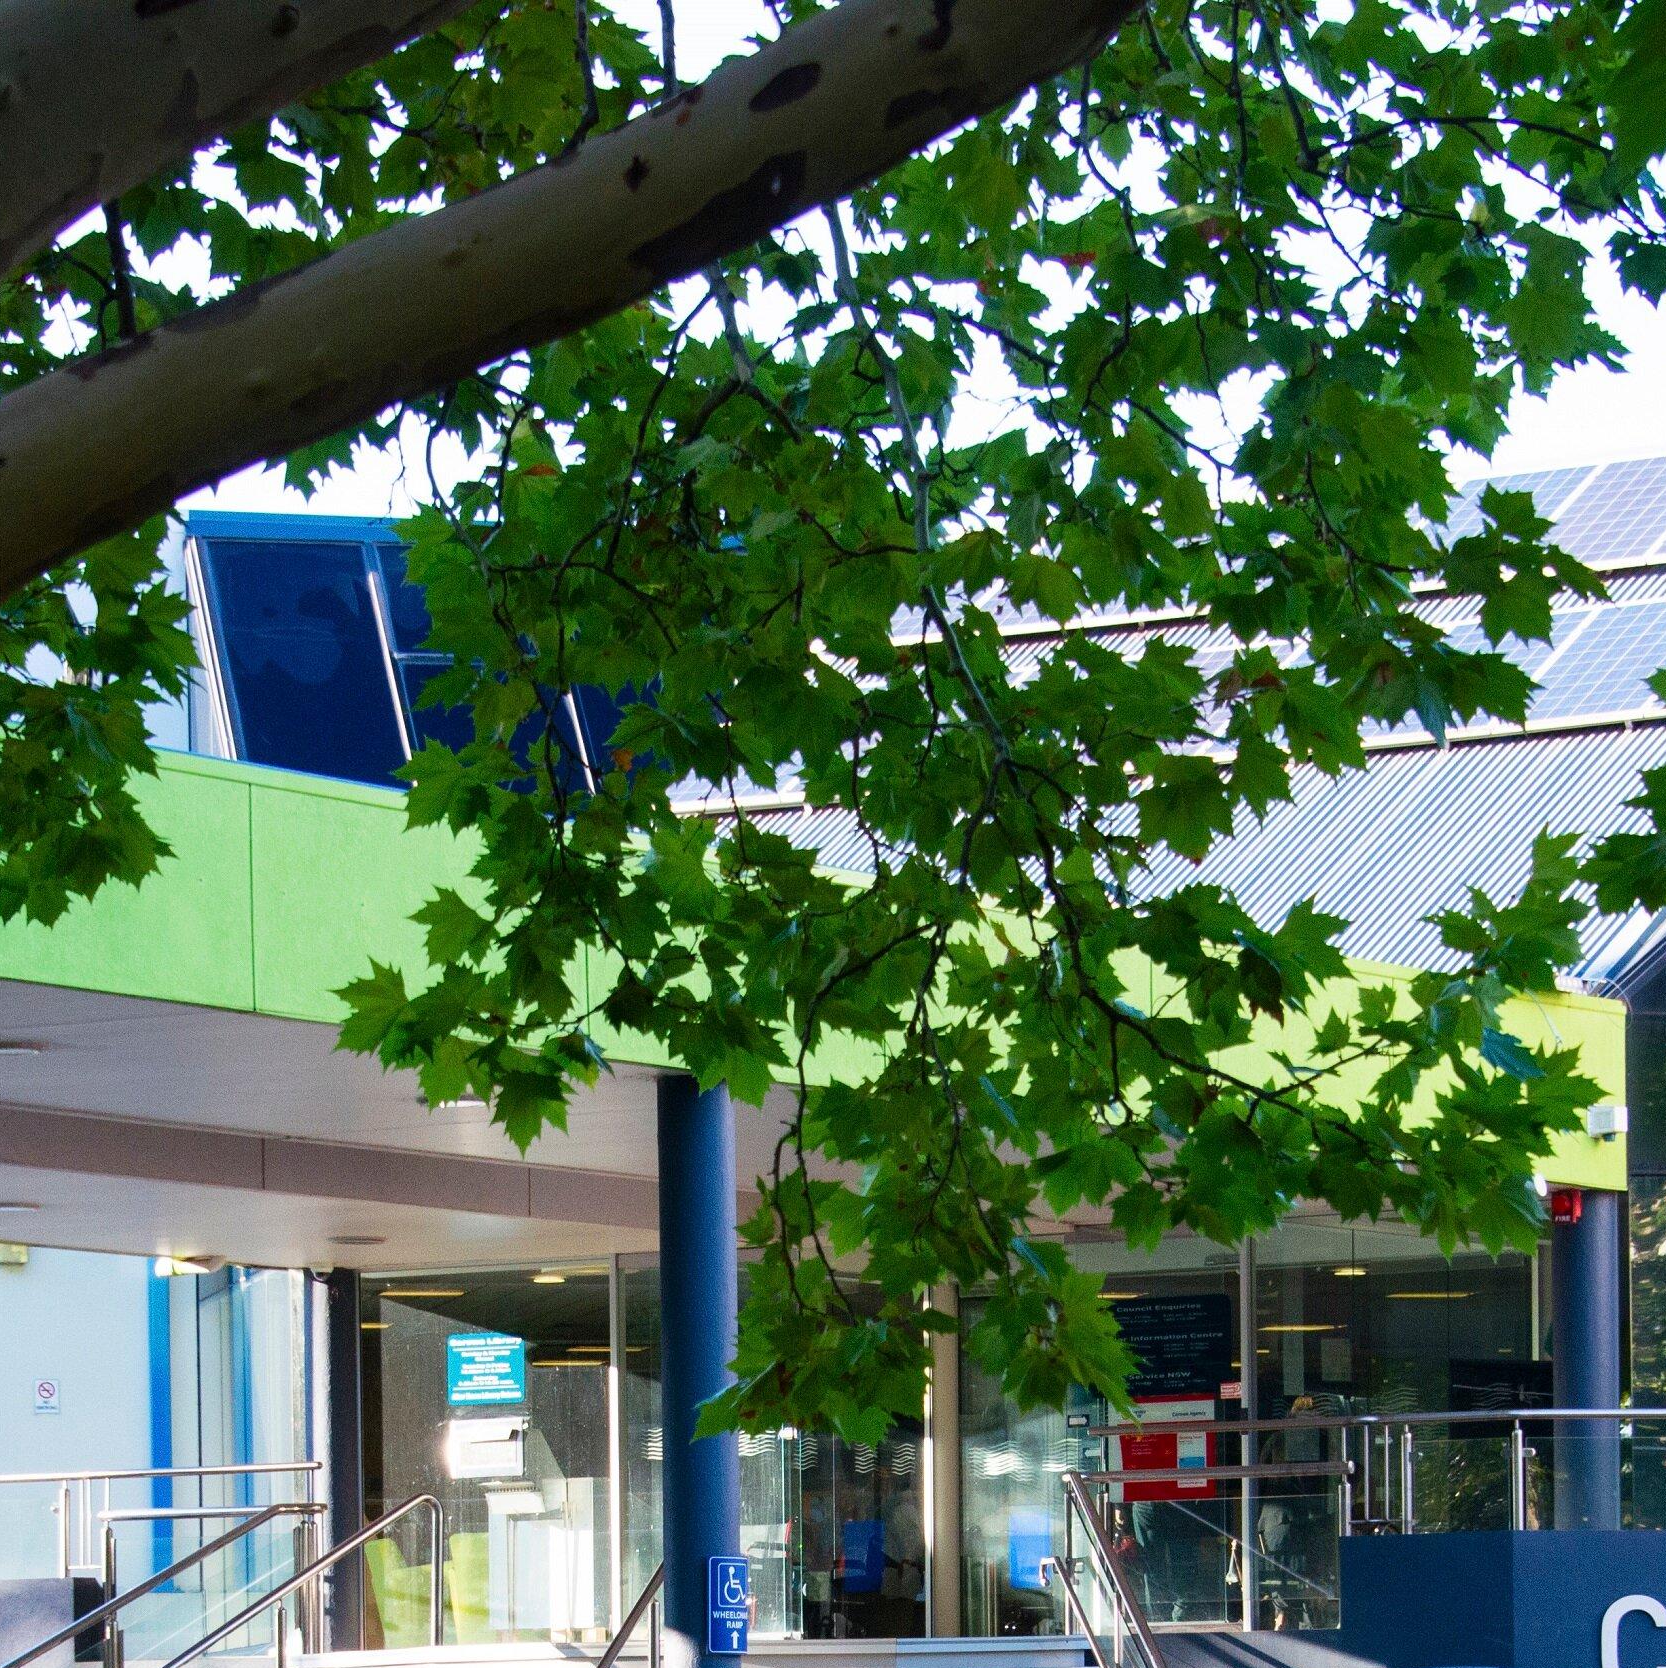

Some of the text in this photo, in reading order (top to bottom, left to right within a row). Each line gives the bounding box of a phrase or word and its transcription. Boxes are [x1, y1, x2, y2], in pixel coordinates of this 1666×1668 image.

[1116, 1303, 1201, 1313] Council Enquiries
[1190, 1331, 1224, 1339] Centre
[1167, 1371, 1191, 1379] NSW
[726, 1621, 744, 1629] RAMP
